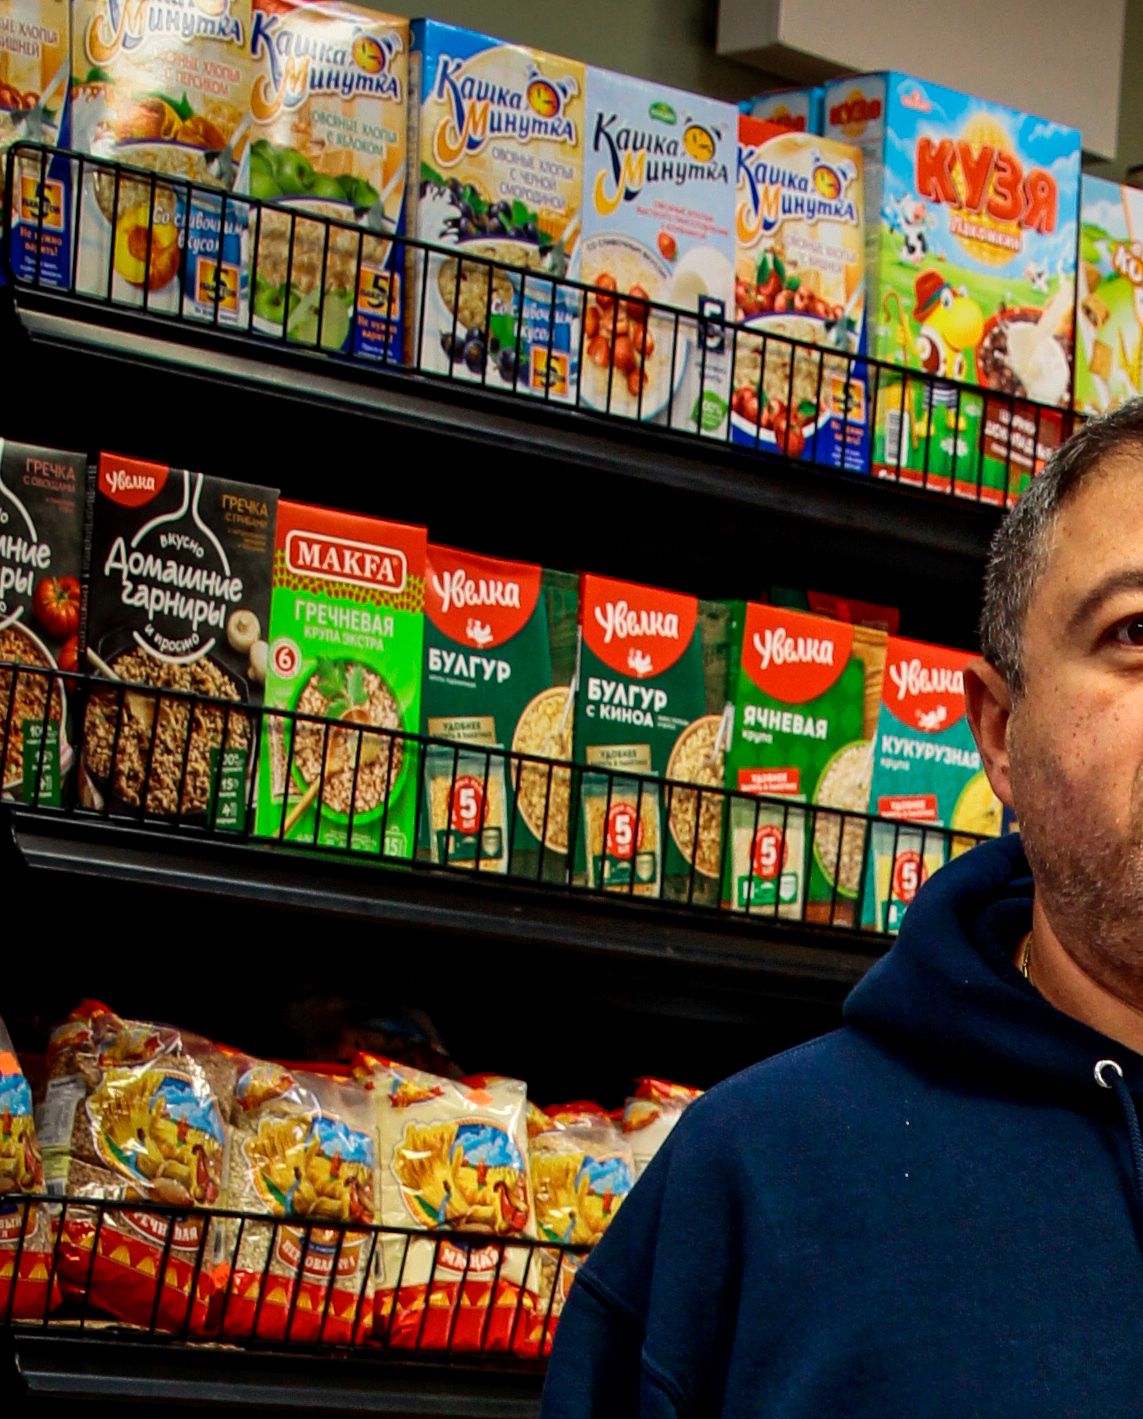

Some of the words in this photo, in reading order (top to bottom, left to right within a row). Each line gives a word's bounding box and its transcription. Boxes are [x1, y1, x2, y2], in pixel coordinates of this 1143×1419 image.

[19, 22, 57, 43] ХЛОПЬЯ
[251, 13, 346, 90] Кашка
[176, 70, 229, 95] ПЕРСИКОМ
[203, 60, 241, 83] ХЛОПЬЯ
[437, 54, 523, 122] Кашка
[251, 58, 400, 121] Минутка
[312, 109, 359, 134] ОВСЯНЫЕ
[361, 121, 398, 144] ХЛОПЬЯ
[326, 129, 333, 144] С
[337, 132, 384, 158] ЯБЛОКОМ
[436, 102, 574, 165] Минутка
[593, 111, 679, 178] Кашка
[492, 146, 535, 170] ОВСЯНЫЕ
[539, 158, 575, 180] ХЛОПЬЯ
[509, 168, 517, 181] С
[737, 146, 808, 205] Кашка
[593, 150, 729, 216] Минутка
[915, 135, 1059, 235] КУЗЯ
[153, 206, 170, 225] Со
[736, 184, 857, 244] Минутка
[367, 273, 390, 308] 5
[22, 474, 30, 486] С
[25, 457, 76, 481] ГРЕЧКА
[222, 494, 269, 518] ГРЕЧКА
[225, 511, 232, 523] С
[158, 532, 206, 559] вкусно
[297, 540, 397, 584] MAKFA
[104, 535, 244, 602] Домашние
[121, 578, 228, 631] гарниры
[432, 569, 521, 613] Увелка
[294, 599, 395, 639] ГРЕЧНЕВАЯ
[594, 600, 680, 644] Увелка
[304, 624, 342, 644] КРУПА
[343, 632, 385, 651] ЭКСТРА
[752, 627, 835, 670] Увелка
[275, 645, 294, 668] 6
[428, 648, 511, 683] БУЛГУР
[587, 677, 668, 712] БУЛГУР
[600, 705, 654, 728] КИНОА
[743, 704, 829, 741] ЯЧНЕВАЯ
[881, 734, 981, 771] КУКУРУЗНАЯ
[459, 788, 477, 819] 5
[615, 814, 632, 845] 5
[760, 836, 777, 866] 5
[901, 861, 919, 891] 5
